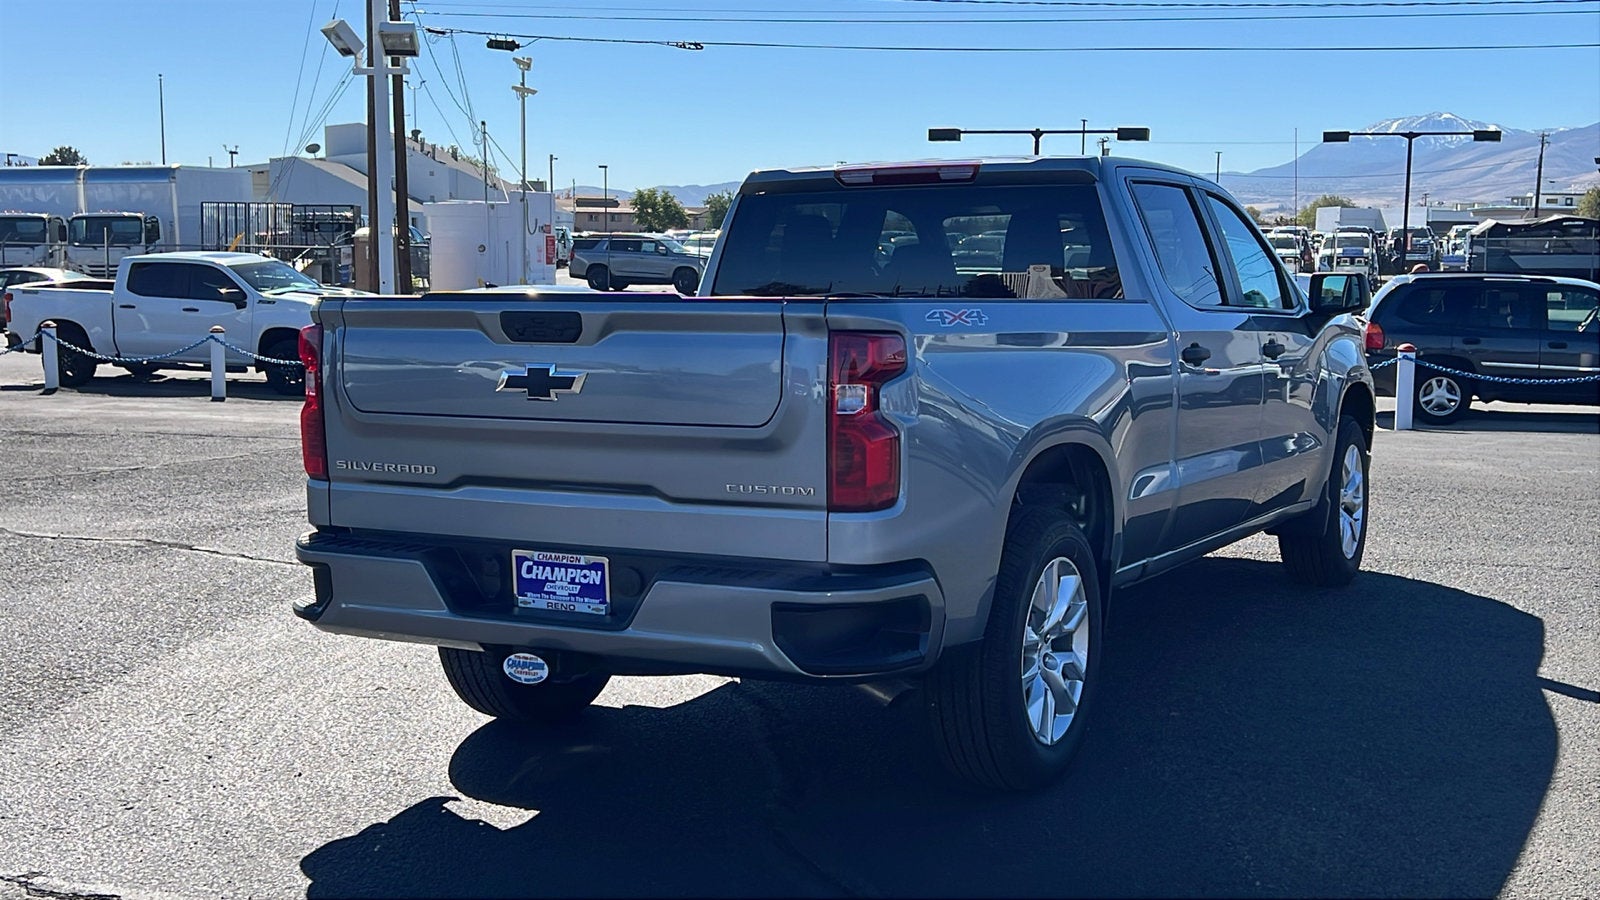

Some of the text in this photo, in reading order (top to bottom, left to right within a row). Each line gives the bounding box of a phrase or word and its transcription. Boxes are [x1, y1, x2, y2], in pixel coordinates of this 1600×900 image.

[336, 460, 436, 475] SILVERADO
[726, 484, 815, 496] CUSTOM
[537, 553, 582, 563] CHAMPION
[521, 561, 602, 585] CHAMPION
[546, 584, 578, 592] CHEVROLET
[546, 602, 576, 611] RENO
